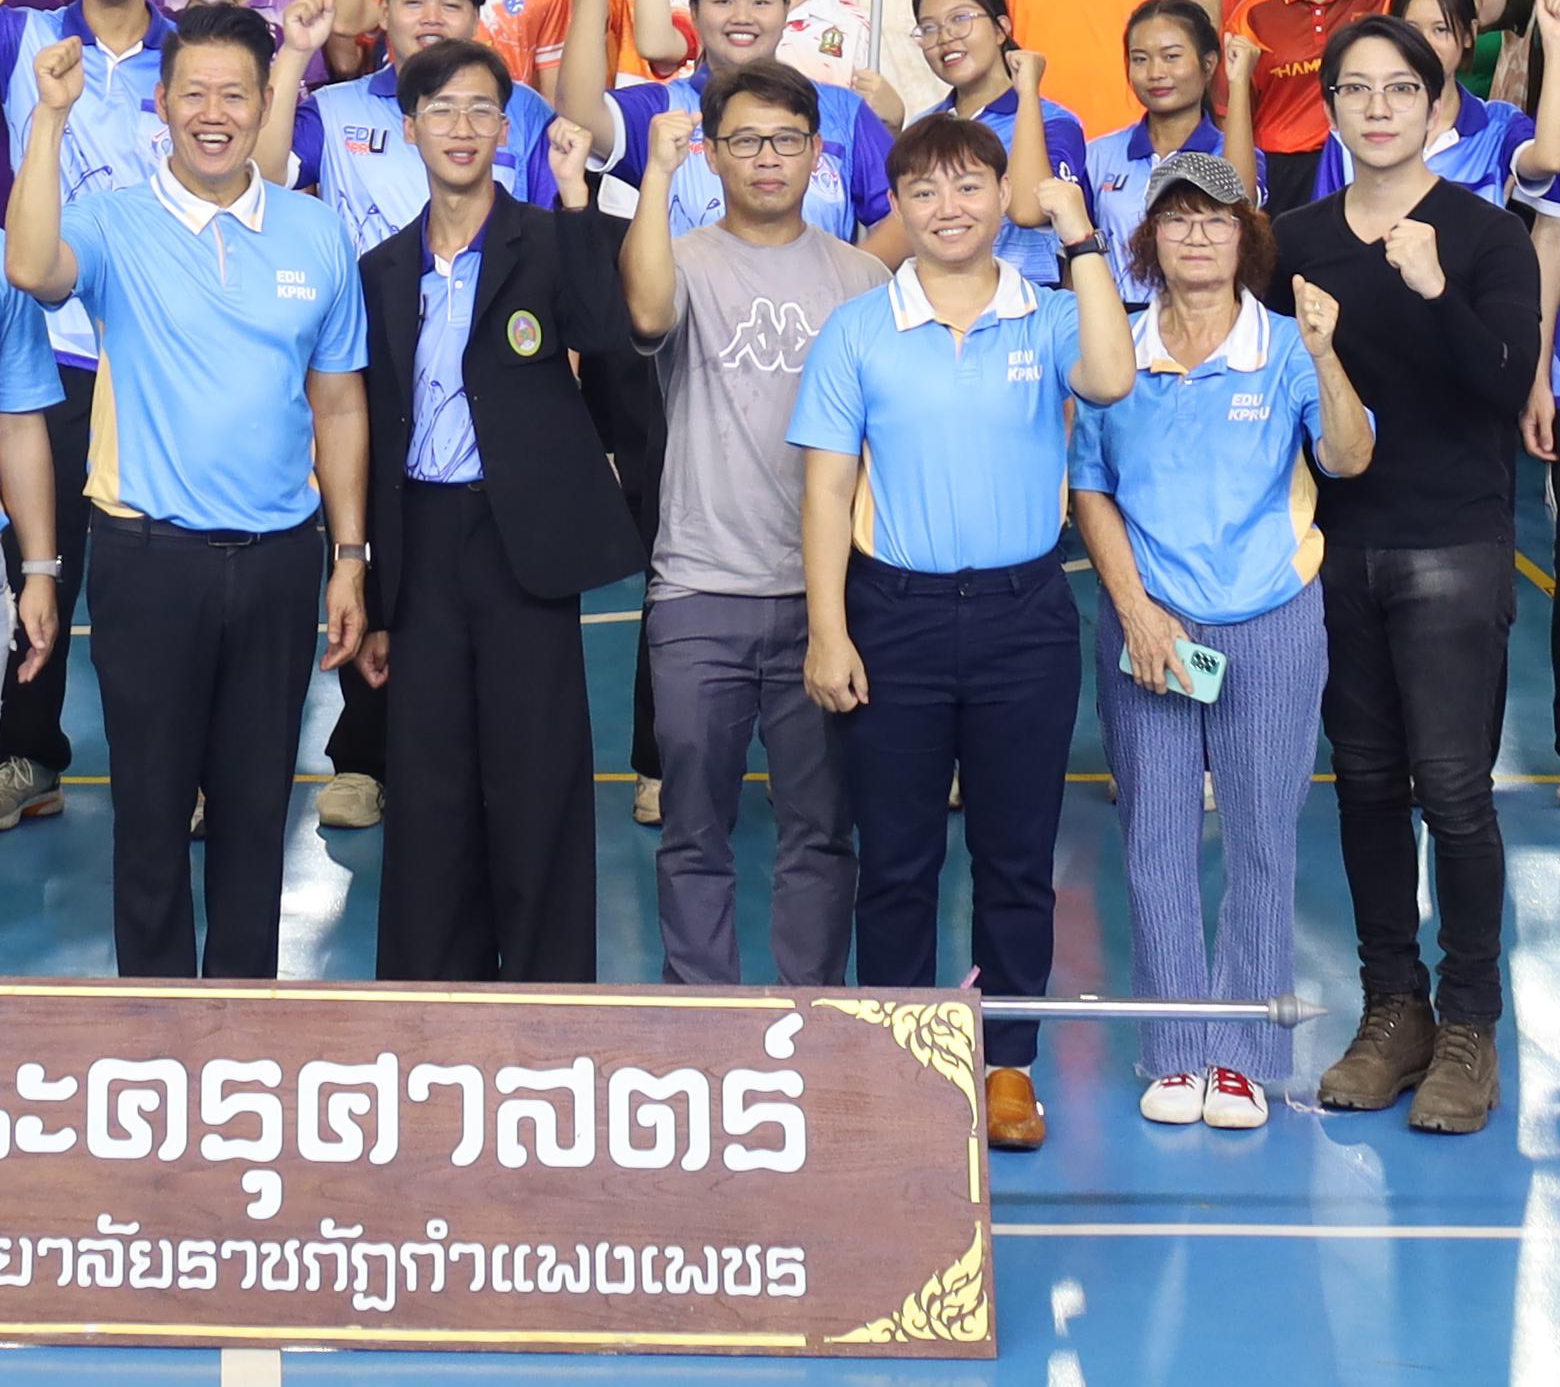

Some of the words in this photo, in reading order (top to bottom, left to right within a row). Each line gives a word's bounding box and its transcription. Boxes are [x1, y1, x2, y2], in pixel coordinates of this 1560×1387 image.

[343, 125, 388, 154] EDU
[276, 269, 306, 285] EDU
[276, 284, 318, 302] KPRU
[1007, 349, 1036, 366] EDU
[1007, 364, 1043, 382] KPRU
[1231, 393, 1265, 407] EDU
[1227, 405, 1271, 422] KPRU
